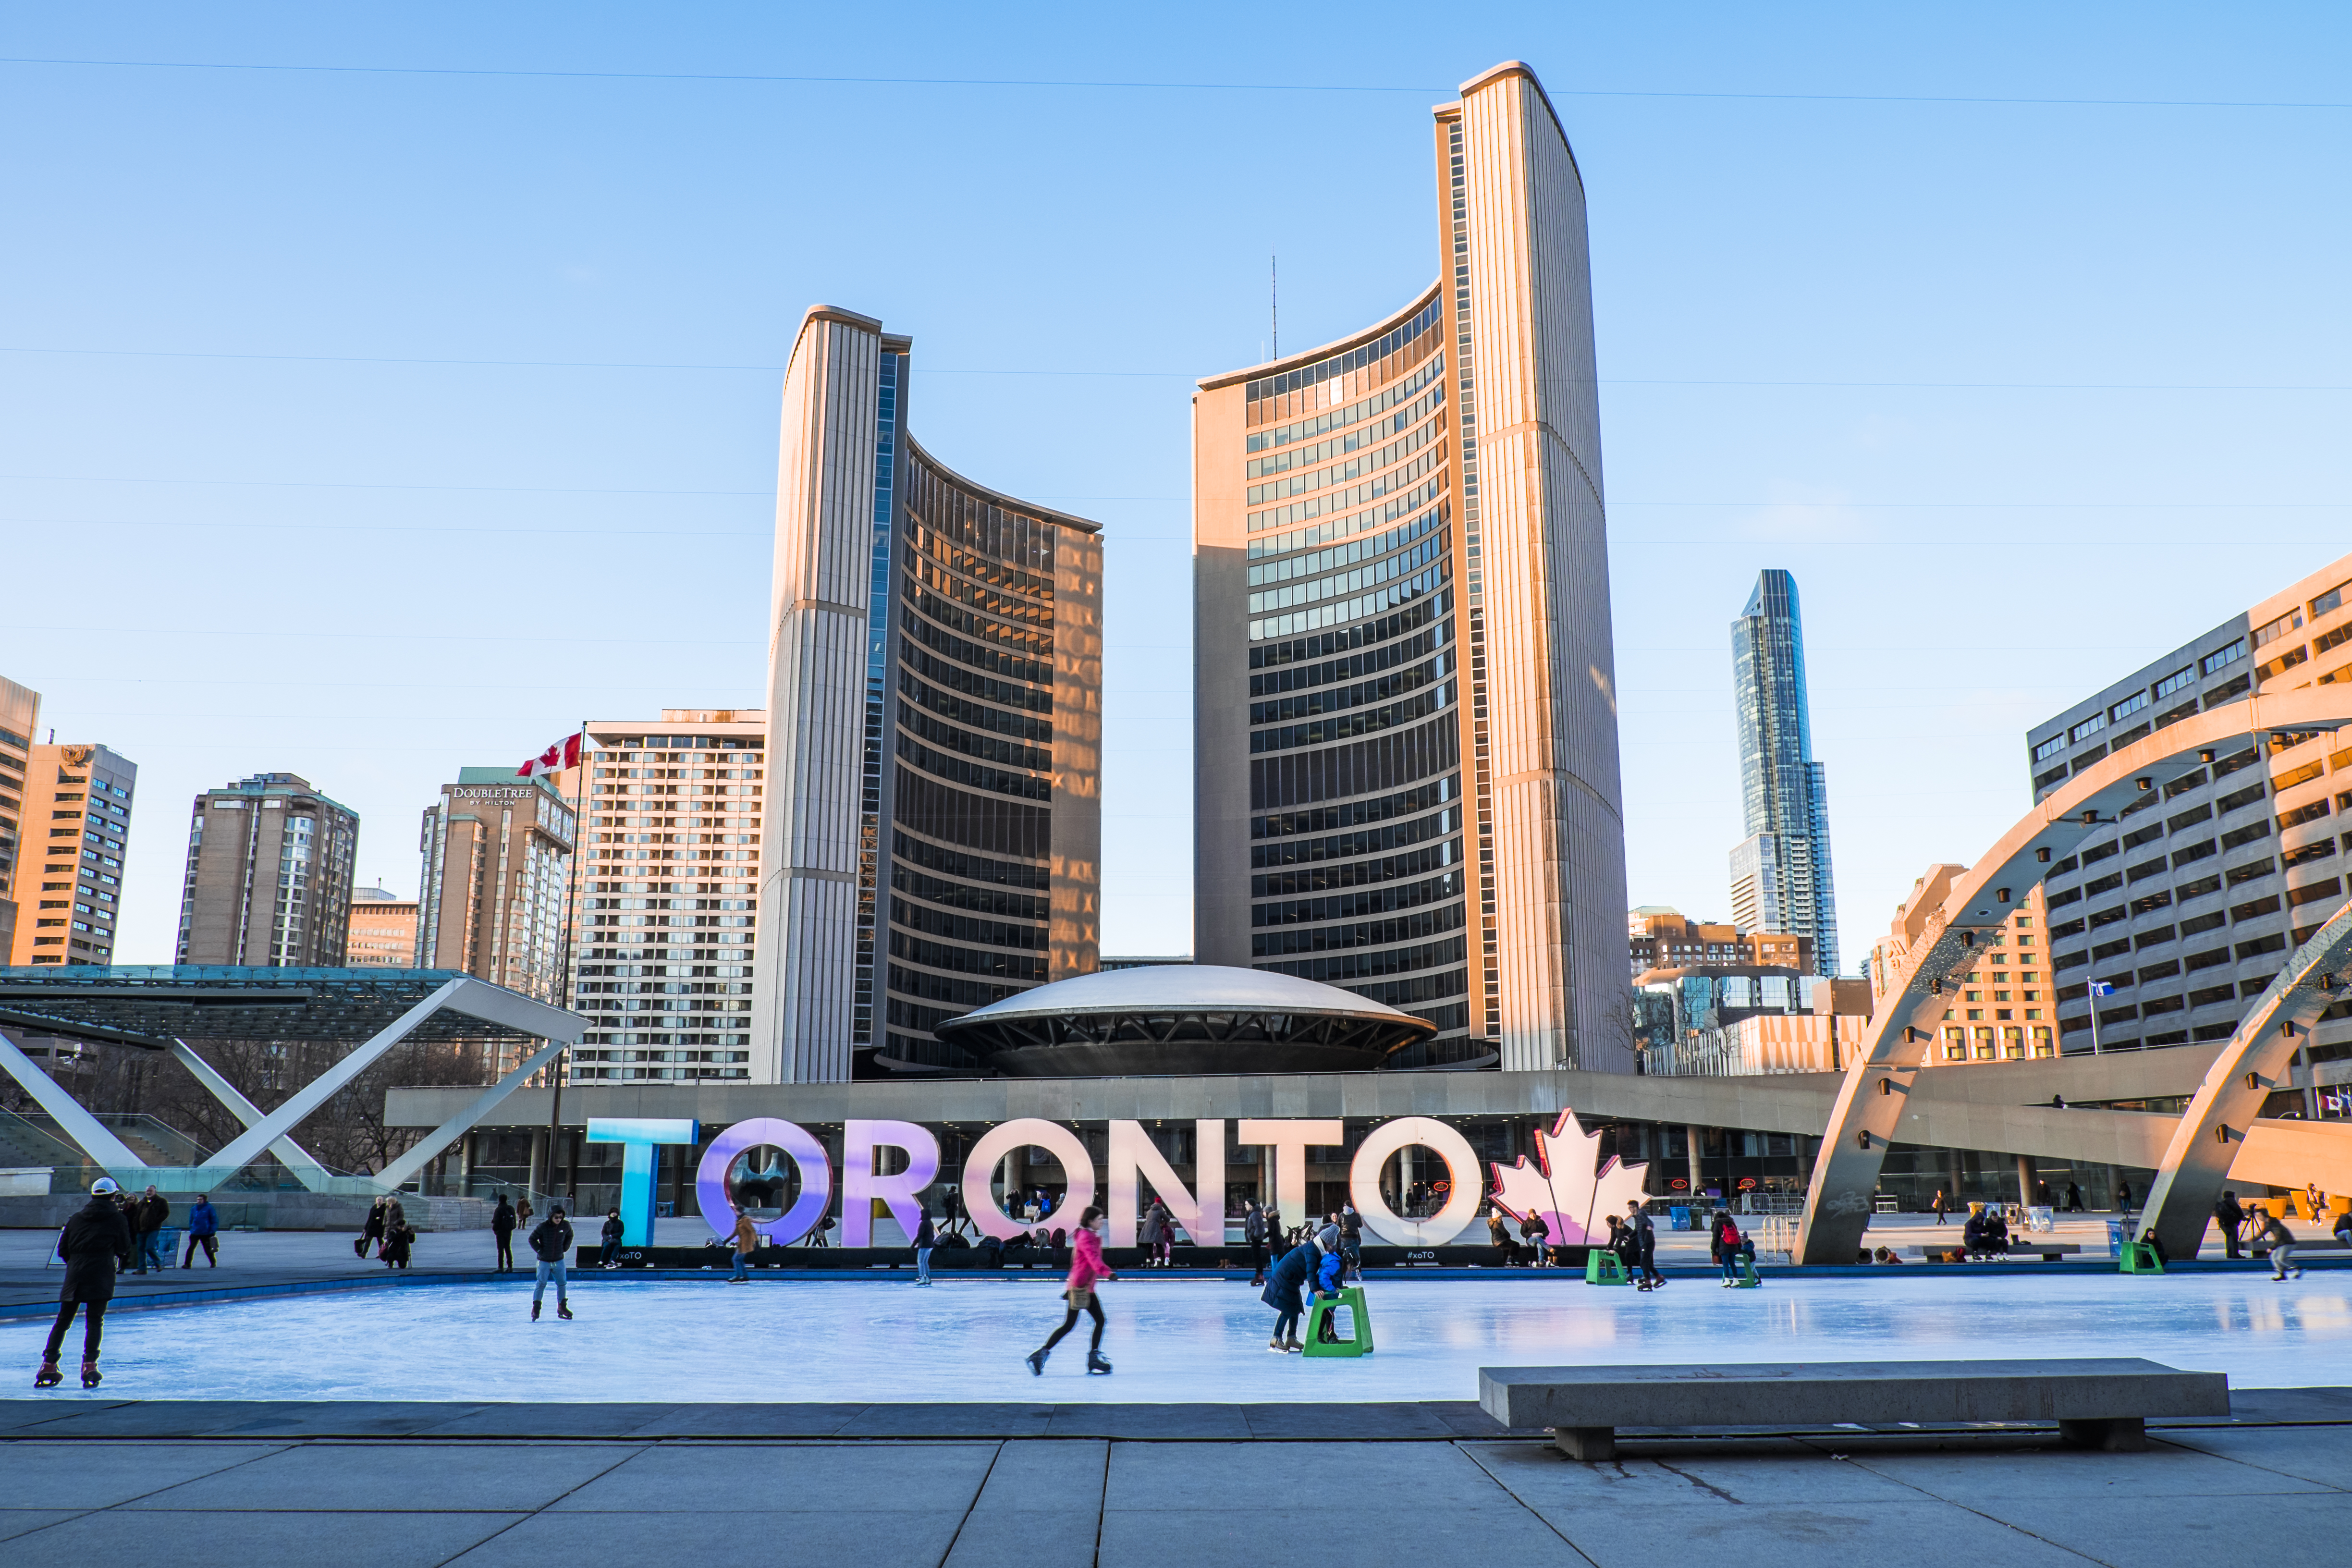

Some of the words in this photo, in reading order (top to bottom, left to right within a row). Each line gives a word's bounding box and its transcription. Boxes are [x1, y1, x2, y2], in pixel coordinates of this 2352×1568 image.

[586, 1116, 1482, 1248] TORONTO
[616, 1251, 642, 1260] xoTO
[1407, 1251, 1434, 1259] #xoTO
